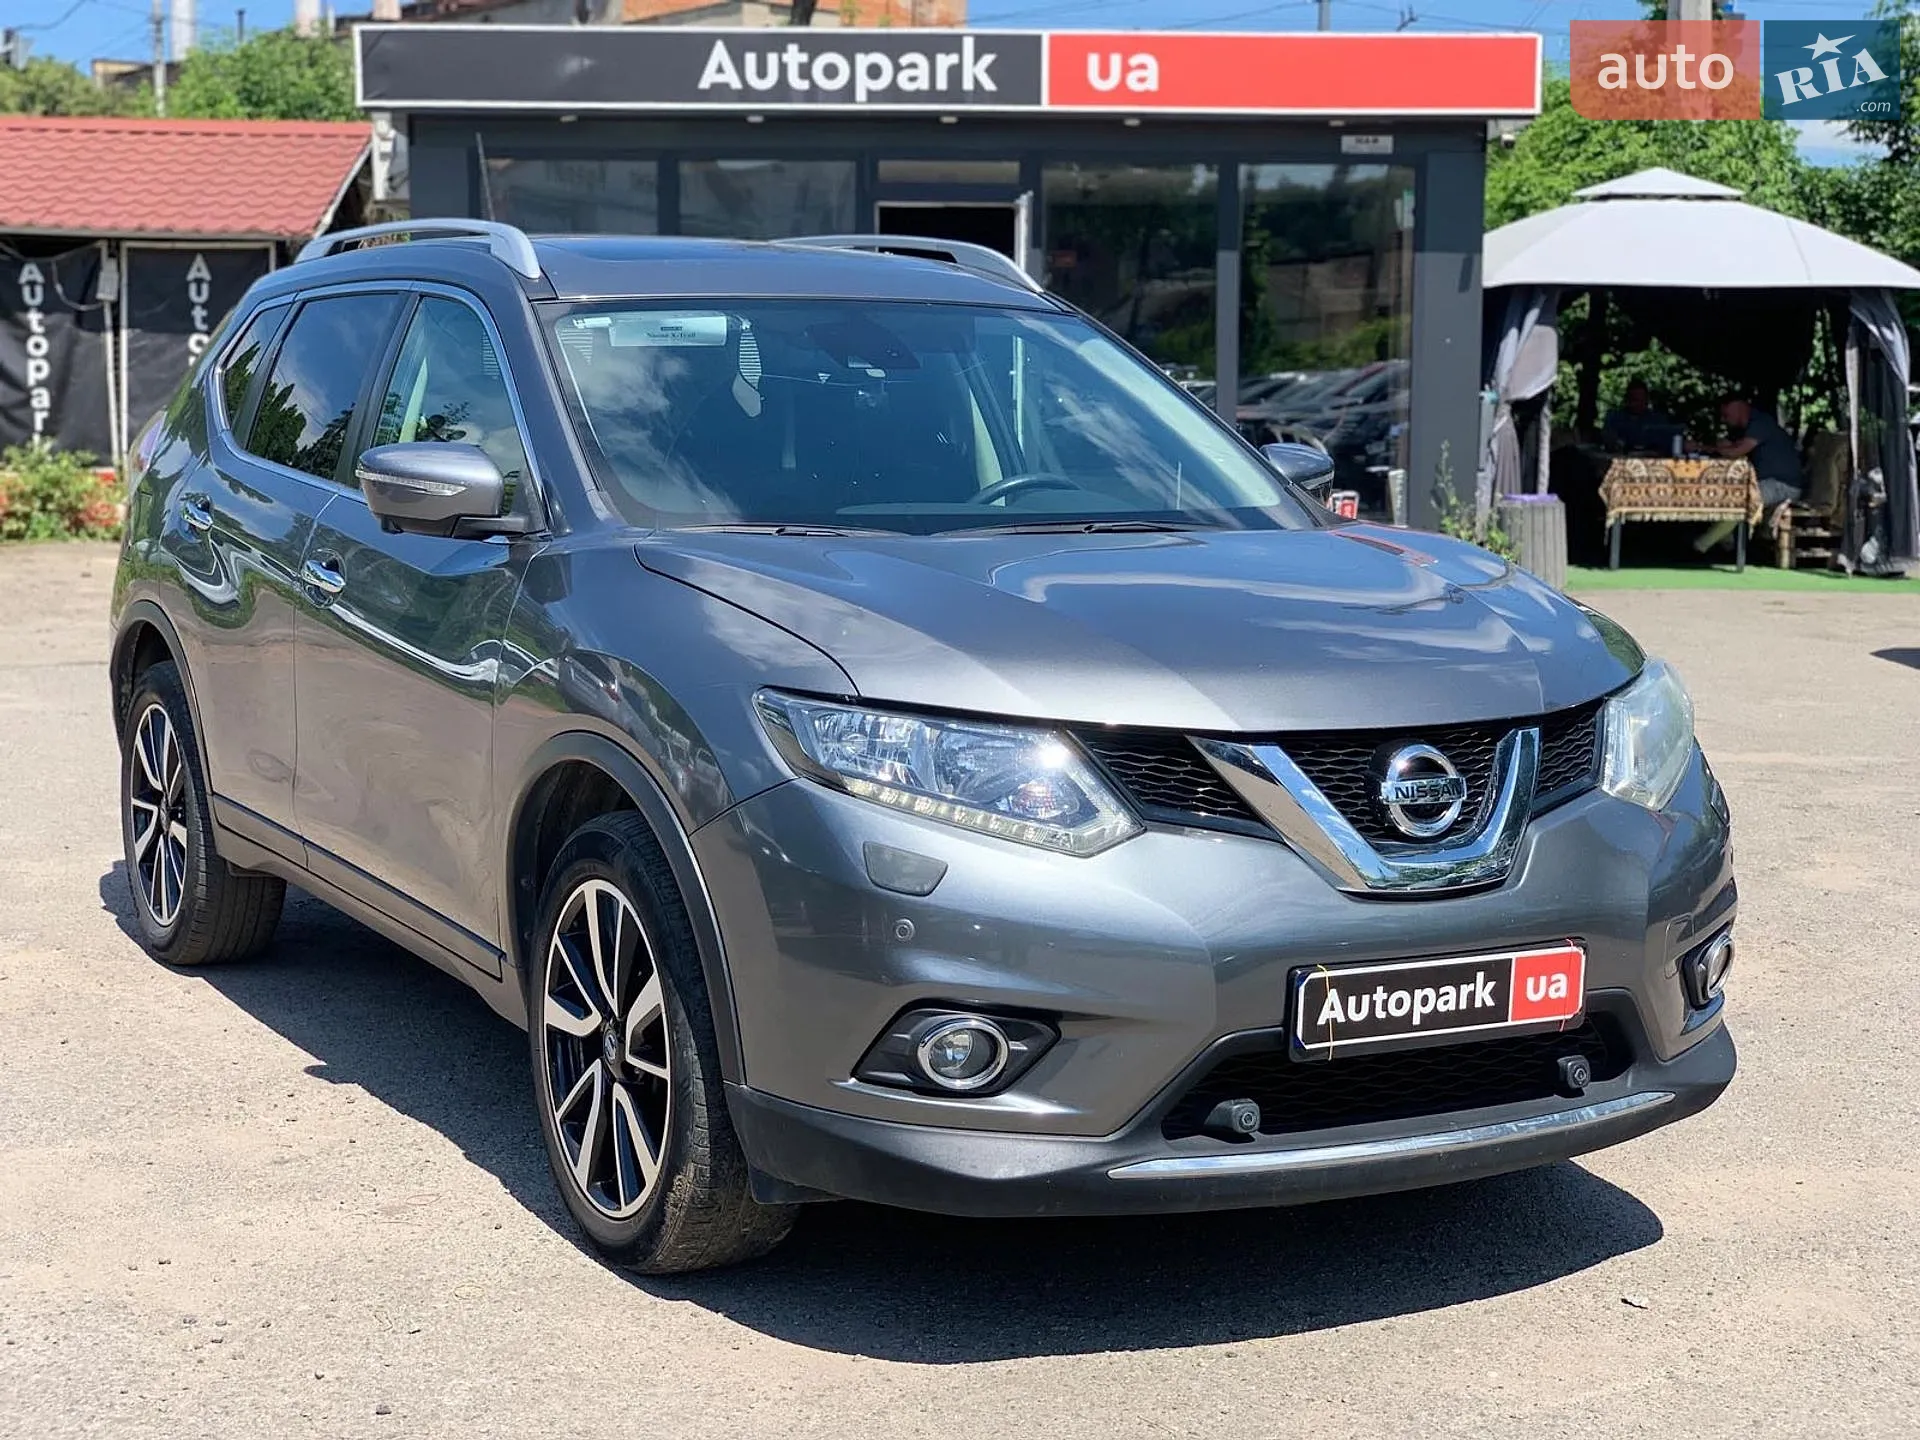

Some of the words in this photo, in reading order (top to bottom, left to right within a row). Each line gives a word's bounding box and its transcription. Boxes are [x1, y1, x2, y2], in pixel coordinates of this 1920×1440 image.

[698, 36, 997, 103] Autopark
[1086, 51, 1160, 92] ua
[18, 262, 51, 443] Autopar
[1395, 783, 1463, 799] NISSAN
[1316, 970, 1497, 1027] Autopark
[1526, 972, 1568, 1002] ua
